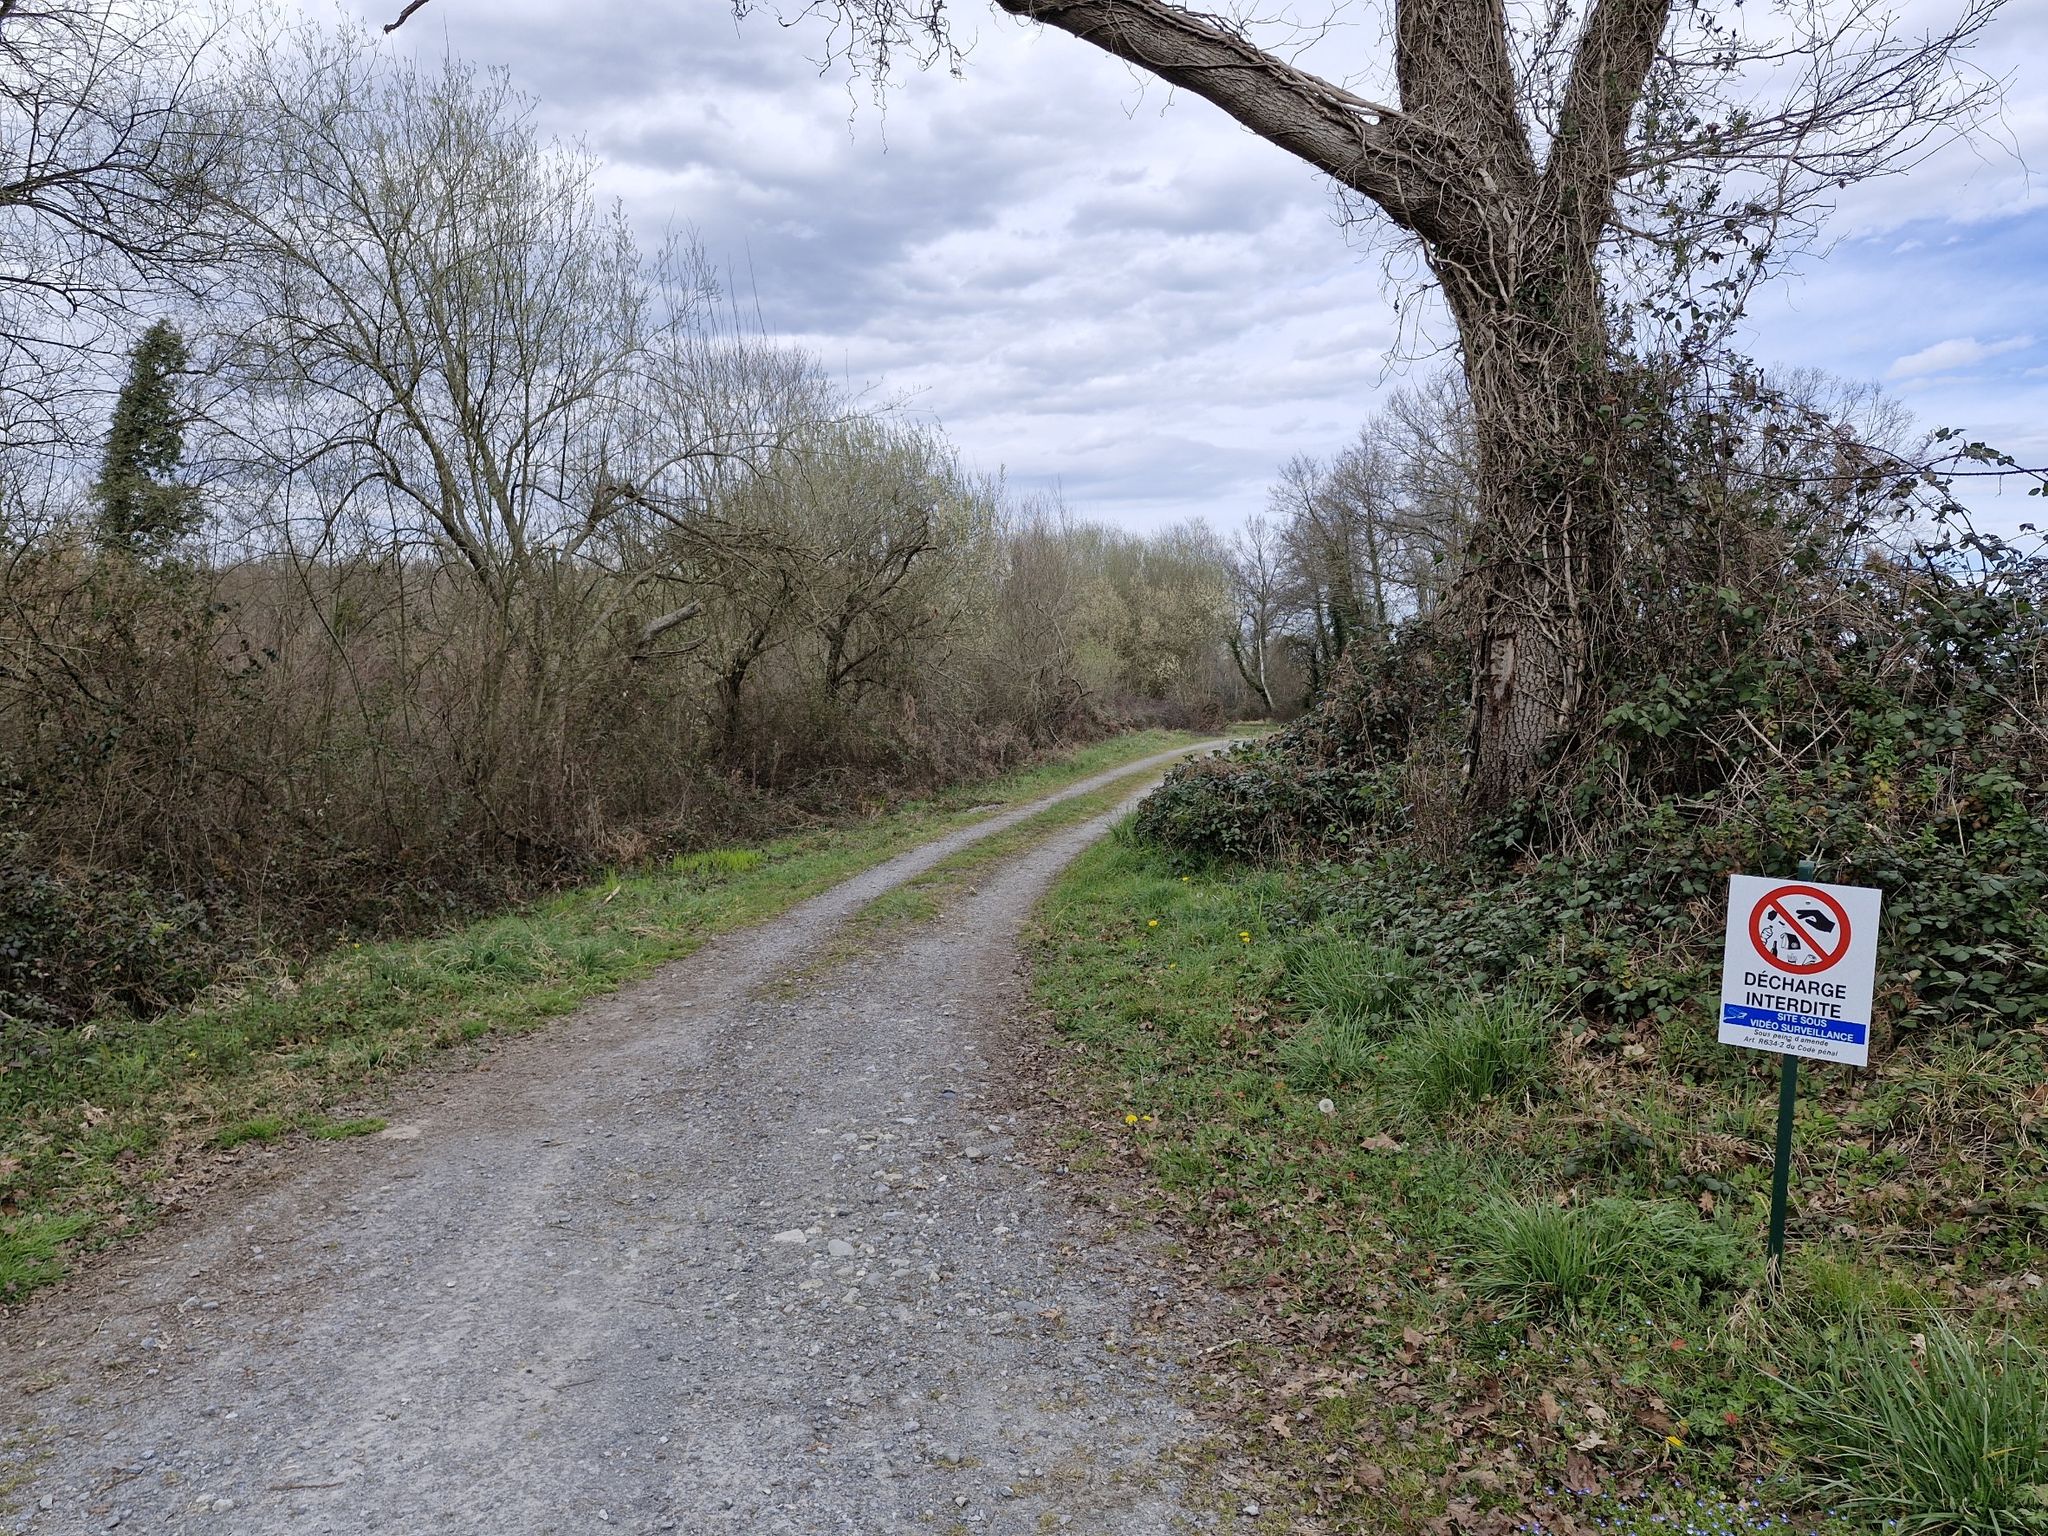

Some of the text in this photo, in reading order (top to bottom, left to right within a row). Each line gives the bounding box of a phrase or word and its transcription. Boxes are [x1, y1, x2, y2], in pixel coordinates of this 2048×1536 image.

[1744, 970, 1847, 999] DÉCHARGE
[1746, 991, 1842, 1019] INTERDITE
[1777, 1012, 1828, 1028] SITE SOUS
[1750, 1019, 1854, 1042] VIDÉO SURVEILLANCE
[1754, 1029, 1771, 1037] Sous
[1797, 1044, 1816, 1053] Code
